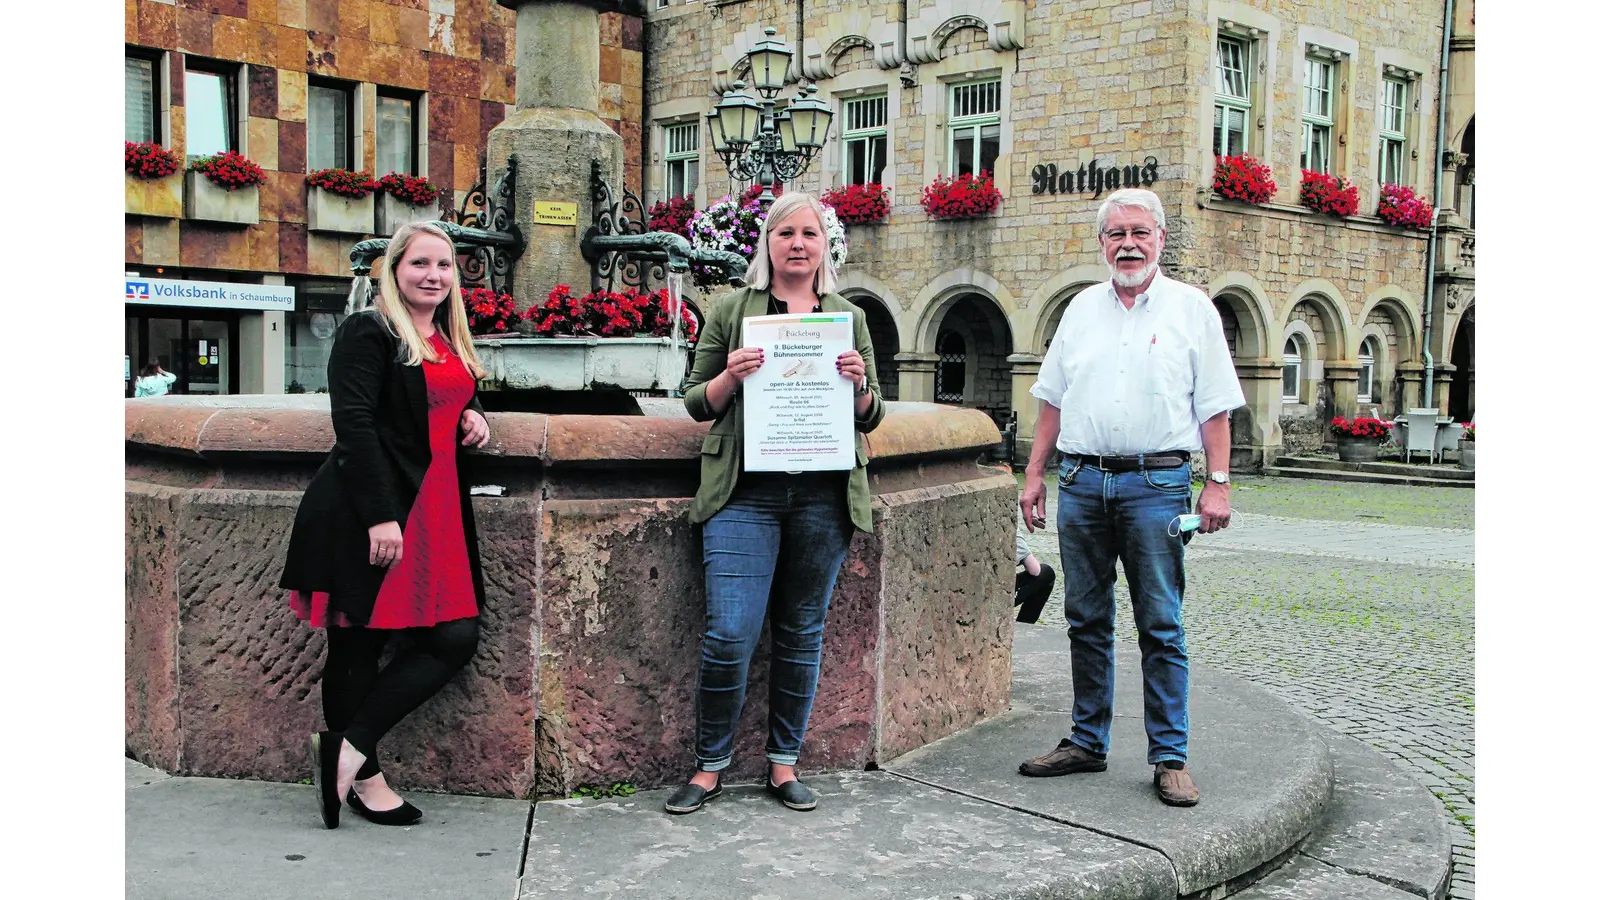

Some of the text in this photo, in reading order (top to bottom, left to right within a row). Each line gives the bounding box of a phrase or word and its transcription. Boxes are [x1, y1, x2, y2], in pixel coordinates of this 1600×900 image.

[1031, 155, 1158, 200] Rathaus
[154, 284, 292, 304] Volksbank in Schaumburg
[271, 321, 277, 331] 1
[786, 329, 821, 339] Bückeburg
